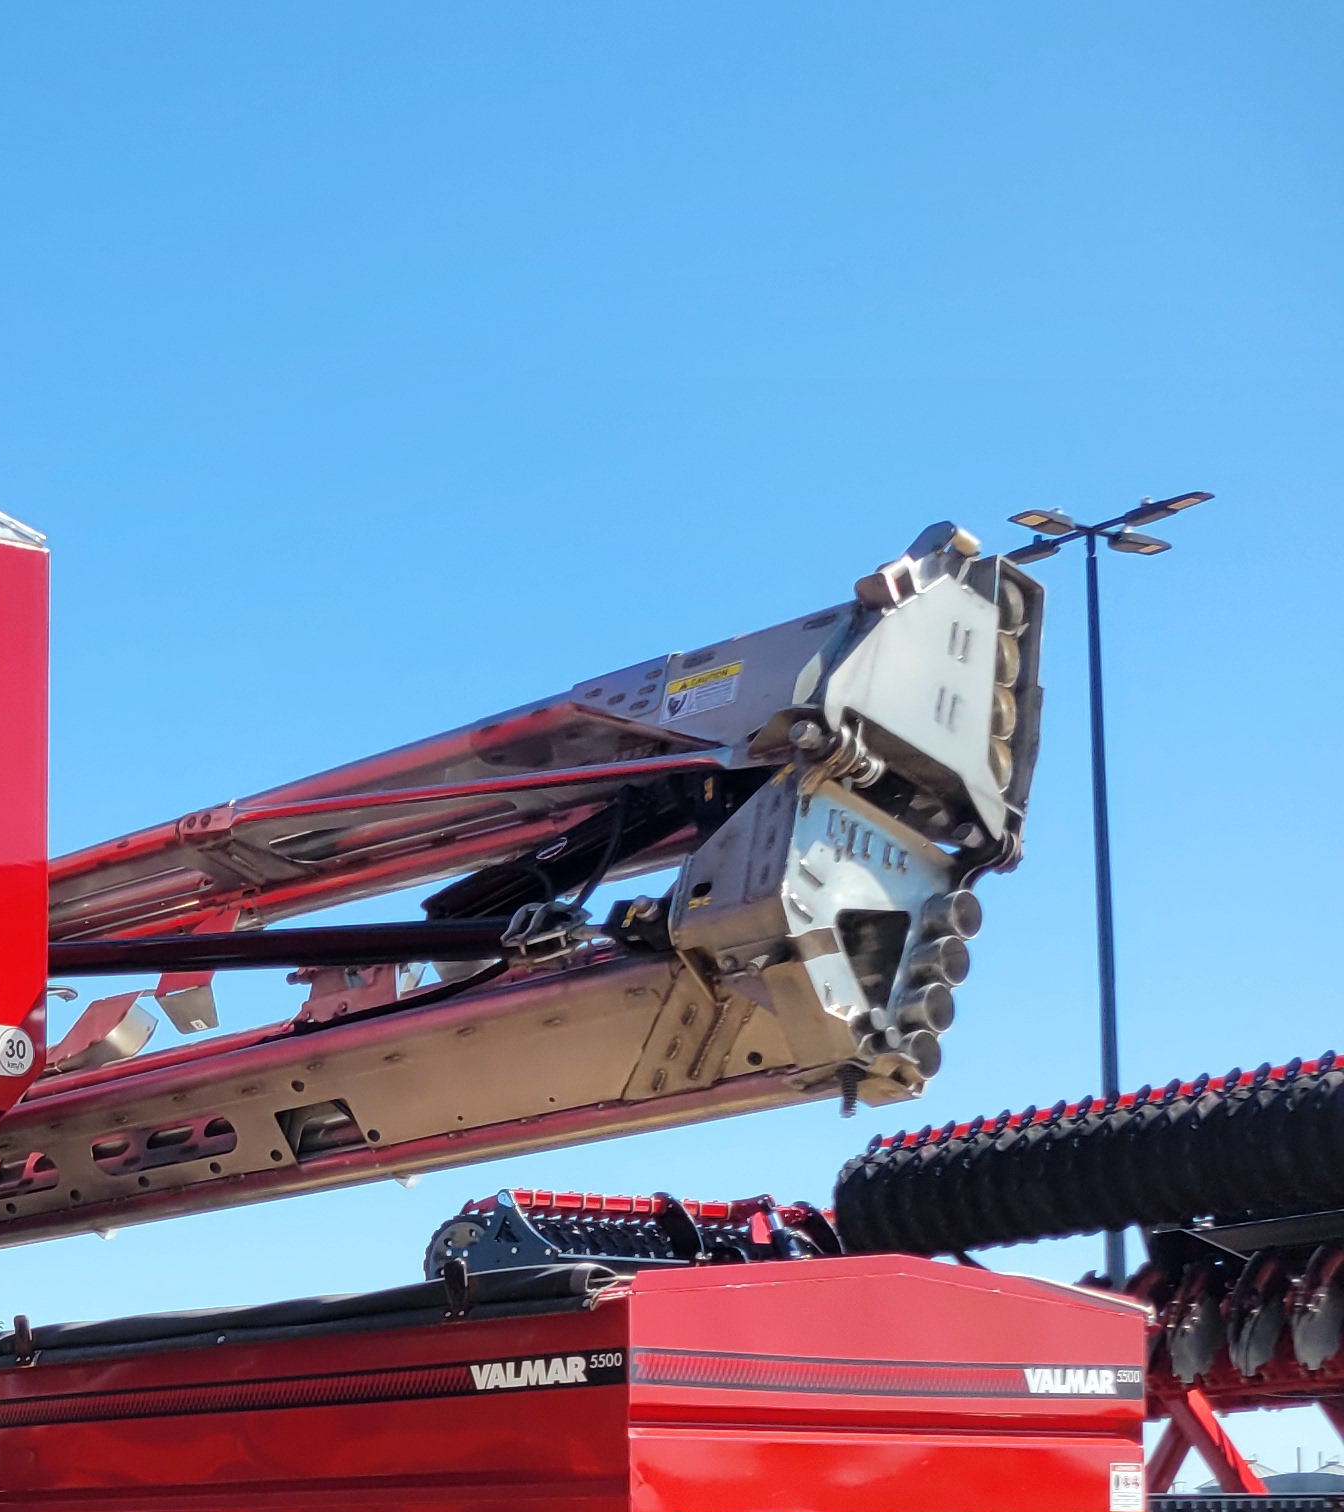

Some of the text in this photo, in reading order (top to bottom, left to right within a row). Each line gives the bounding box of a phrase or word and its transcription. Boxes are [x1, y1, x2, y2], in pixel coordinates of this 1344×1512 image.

[5, 1038, 26, 1059] 30
[7, 1061, 25, 1071] km/h
[470, 1352, 623, 1391] VALMAR 5500
[1023, 1368, 1140, 1394] VALMAR 5500
